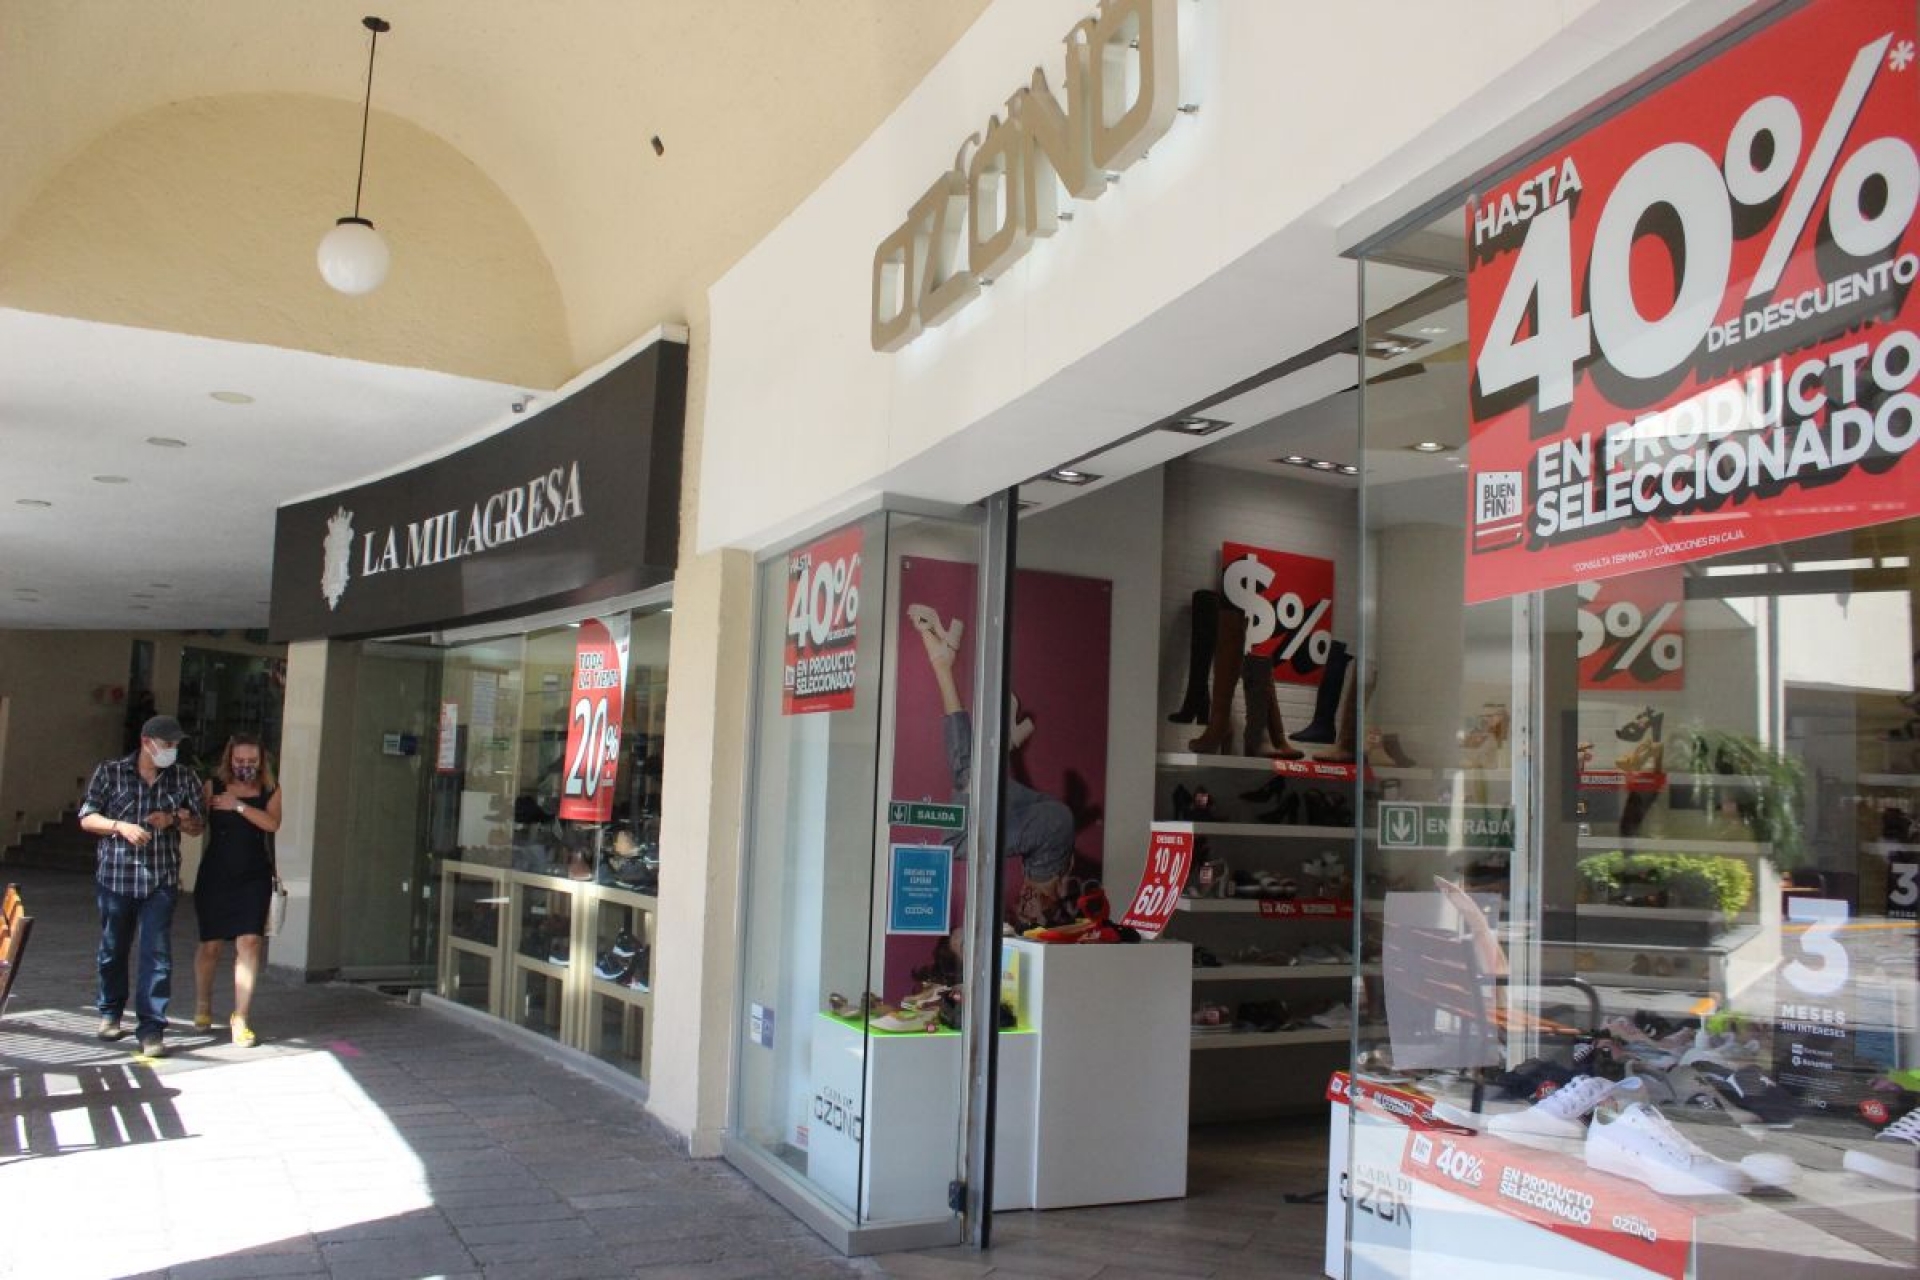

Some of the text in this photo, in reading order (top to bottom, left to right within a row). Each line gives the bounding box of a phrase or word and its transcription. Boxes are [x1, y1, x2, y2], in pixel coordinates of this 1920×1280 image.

[871, 0, 1180, 352] OZONO
[1475, 156, 1583, 246] HASTA
[1708, 252, 1920, 353] DE DESCUENTO
[1537, 330, 1920, 491] EN PRODUCTO
[1535, 393, 1920, 537] SELECCIONADO
[1483, 481, 1516, 500] BUEN
[363, 461, 584, 577] LA MILAGRESA
[1655, 537, 1708, 556] CONDICIONES
[1708, 534, 1721, 545] EN
[1224, 553, 1331, 661] $%
[796, 670, 855, 695] SELECCIONADO
[810, 651, 855, 675] PRODUCTO
[917, 810, 956, 822] SALIDA
[1154, 848, 1170, 874] 10
[1134, 884, 1165, 916] 60
[1888, 863, 1919, 905] 3
[1782, 896, 1849, 996] 3
[1781, 1004, 1846, 1025] MESES
[1436, 1147, 1485, 1182] 40%
[1500, 1180, 1592, 1226] SELECCIONADO
[1502, 1166, 1594, 1210] EN PRODUCTO
[1612, 1215, 1658, 1243] OZONO
